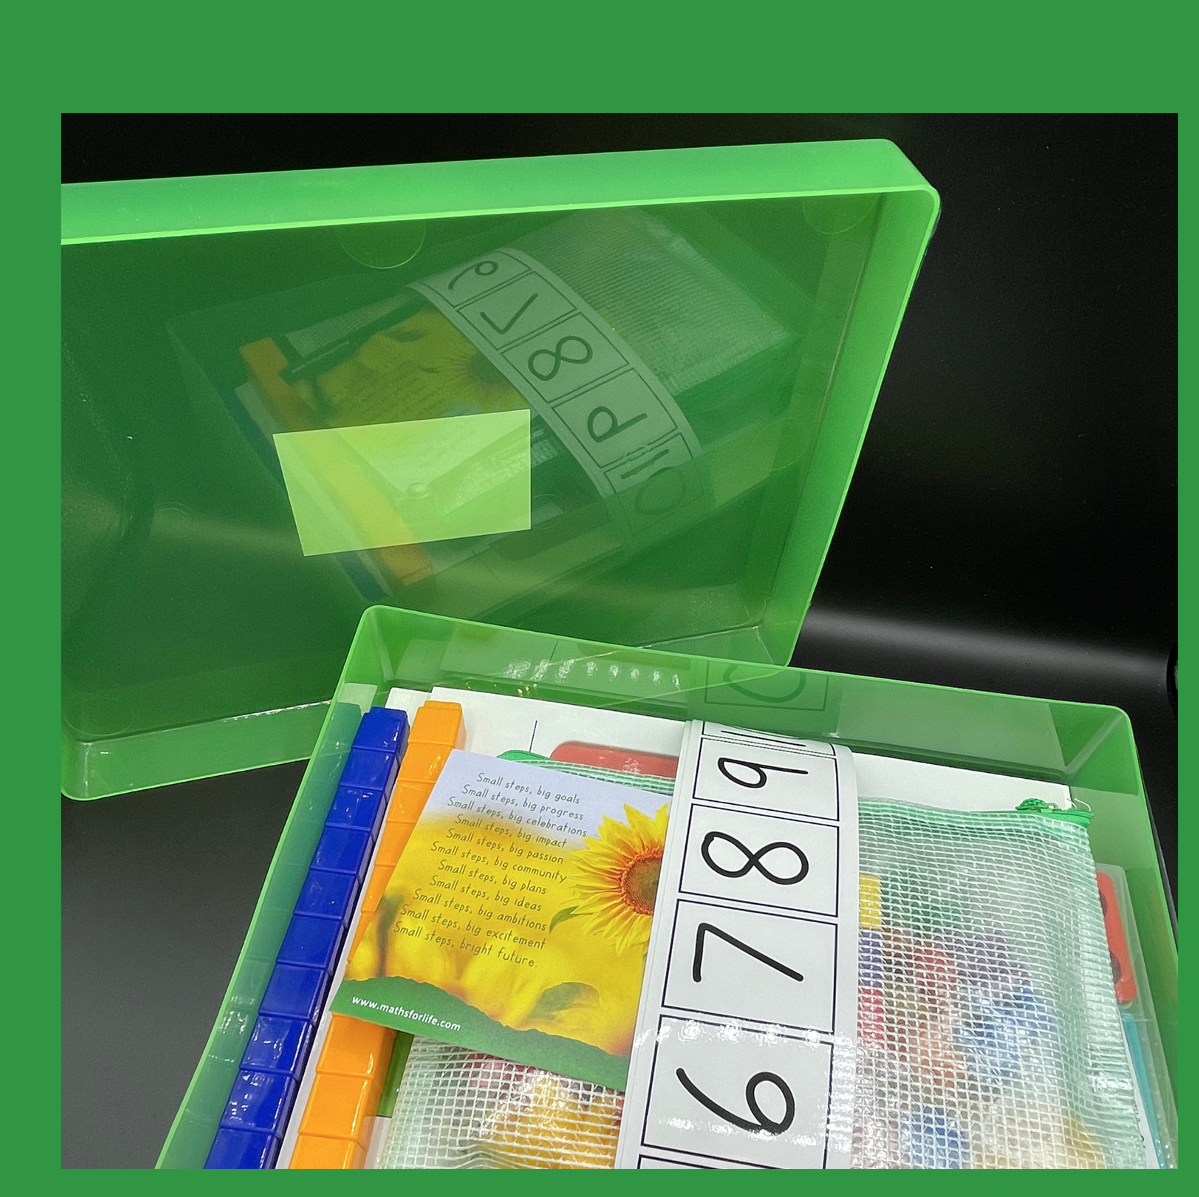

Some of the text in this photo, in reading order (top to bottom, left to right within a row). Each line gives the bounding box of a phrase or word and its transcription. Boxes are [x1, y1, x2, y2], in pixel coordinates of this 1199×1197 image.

[476, 772, 580, 804] Small steps, big goals
[717, 756, 809, 789] 9
[447, 796, 587, 837] Small steps, big celebrations
[461, 784, 584, 820] Small steps, big progress
[446, 828, 564, 864] Small steps, big passion
[454, 813, 567, 848] Small steps, big impact
[430, 840, 567, 884] Small steps, big community
[700, 830, 810, 886] 8
[429, 874, 542, 912] Small steps, big ideas
[438, 859, 547, 895] Small steps, big plans
[400, 904, 546, 950] Small steps, big excitement
[412, 888, 546, 931] Small steps, big ambitions
[393, 920, 423, 938] Small
[424, 930, 454, 948] steps,
[460, 937, 493, 956] bright
[692, 922, 804, 983] 7
[352, 996, 461, 1032] www.mathsforlife.com
[676, 1067, 796, 1136] 6
